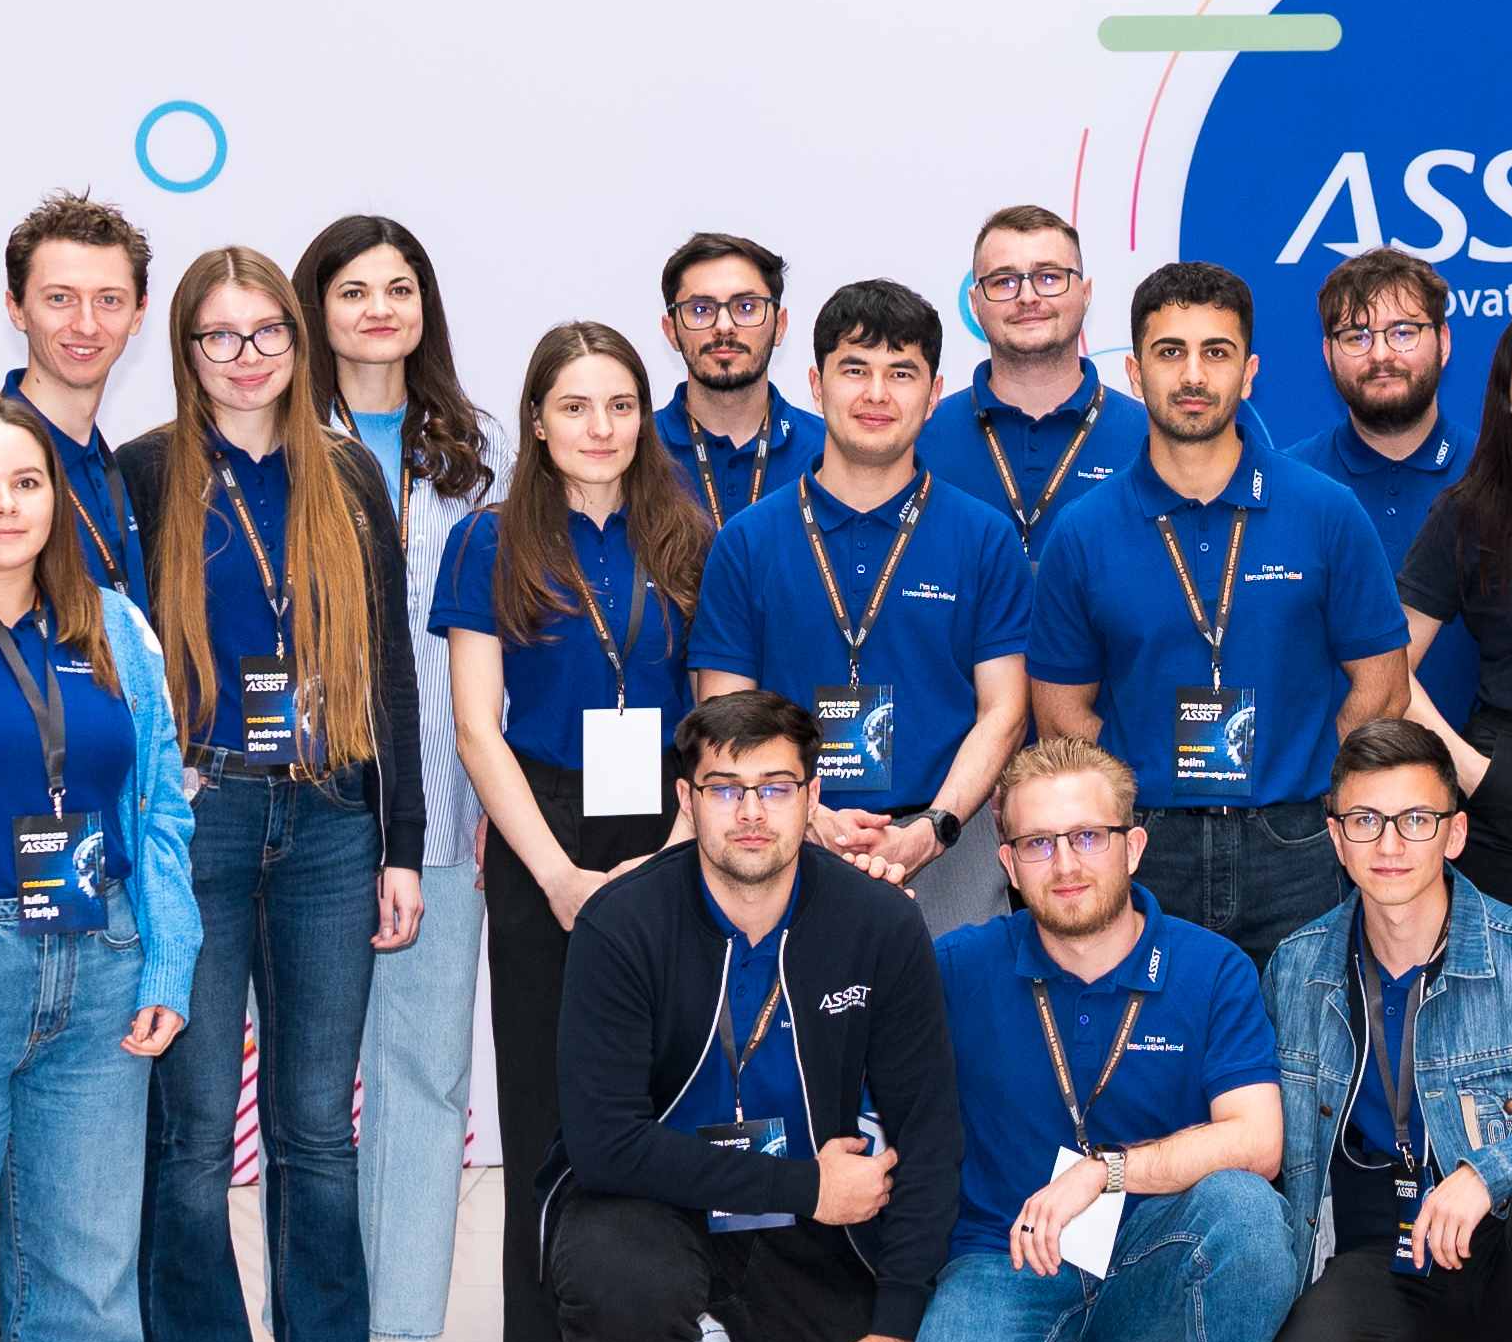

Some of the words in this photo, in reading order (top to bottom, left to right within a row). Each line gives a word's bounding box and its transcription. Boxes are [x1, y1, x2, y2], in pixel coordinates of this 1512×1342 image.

[1252, 468, 1263, 501] ASSIST
[245, 680, 288, 692] ASSIST
[818, 708, 861, 719] ASSIST
[1180, 710, 1223, 721] ASSIST
[248, 729, 292, 739] Andreea
[20, 839, 68, 854] ASSIST
[1147, 946, 1162, 984] ASSIST
[819, 985, 872, 1010] ASSIST
[1396, 1187, 1418, 1199] ASSIST
